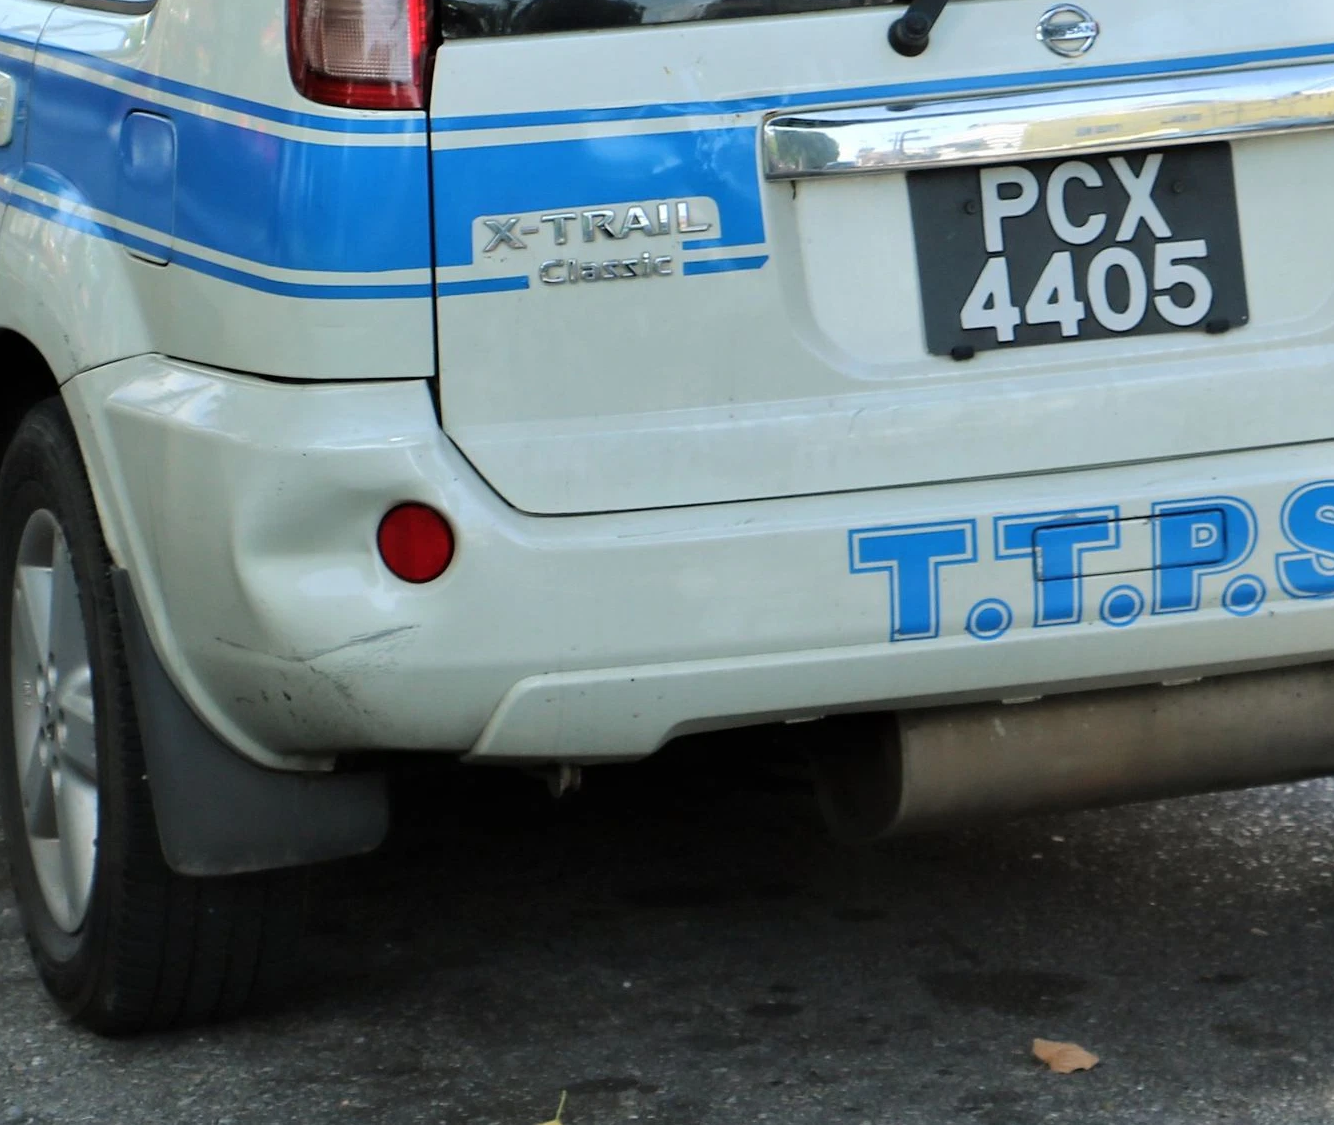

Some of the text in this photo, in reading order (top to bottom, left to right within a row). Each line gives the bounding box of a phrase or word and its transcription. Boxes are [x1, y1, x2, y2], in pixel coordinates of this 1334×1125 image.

[482, 201, 713, 253] X-TRAIL
[979, 153, 1172, 253] PCX
[538, 251, 673, 285] Classic
[959, 239, 1213, 342] 4405
